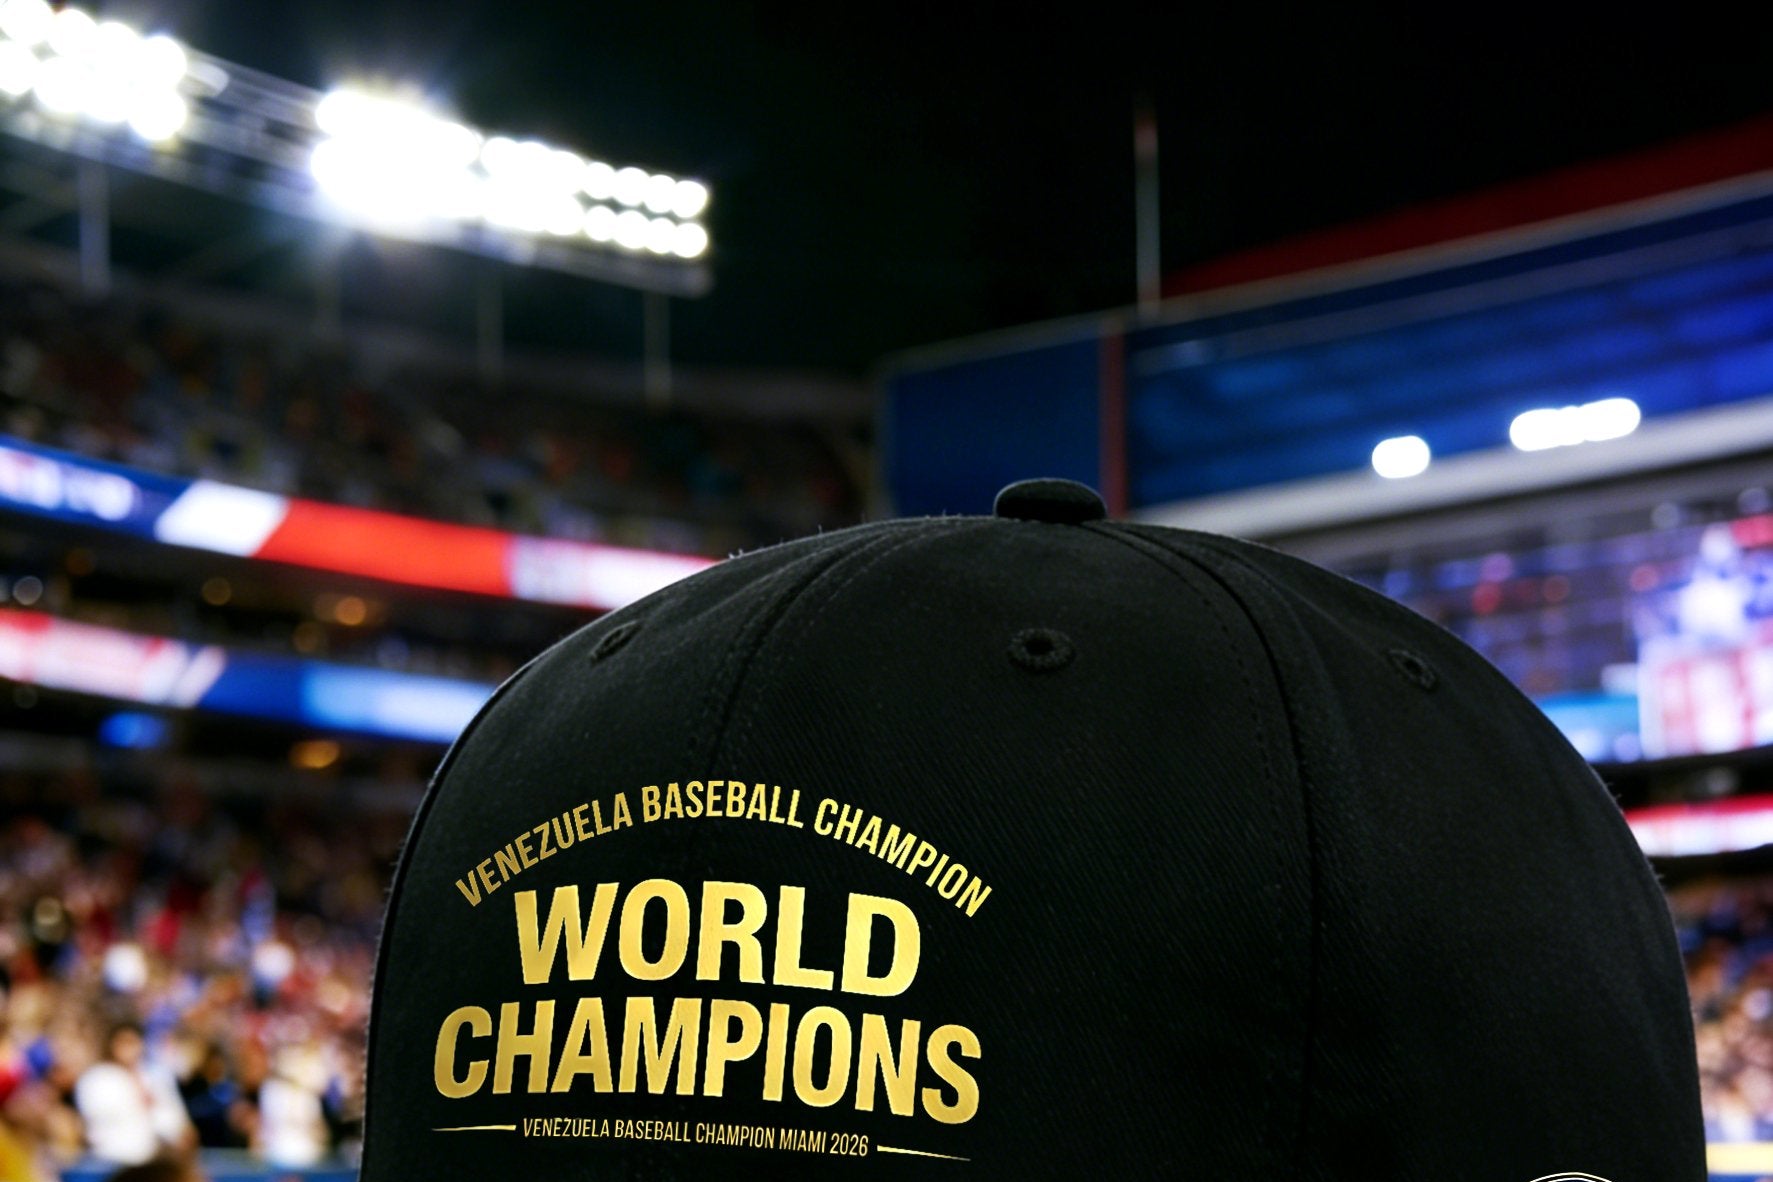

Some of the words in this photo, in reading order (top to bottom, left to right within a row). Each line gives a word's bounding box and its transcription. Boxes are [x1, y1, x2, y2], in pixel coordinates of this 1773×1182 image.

[455, 792, 633, 907] VENEZUELA
[641, 780, 803, 828] BASEBALL
[815, 798, 992, 918] CHAMPION
[514, 879, 921, 997] WORLD
[433, 997, 982, 1125] CHAMPIONS
[523, 1117, 610, 1139] VENEZUELA
[614, 1119, 692, 1143] BASEBALL
[695, 1122, 776, 1149] CHAMPION
[779, 1129, 827, 1154] MIAMI
[830, 1133, 870, 1157] 2026
